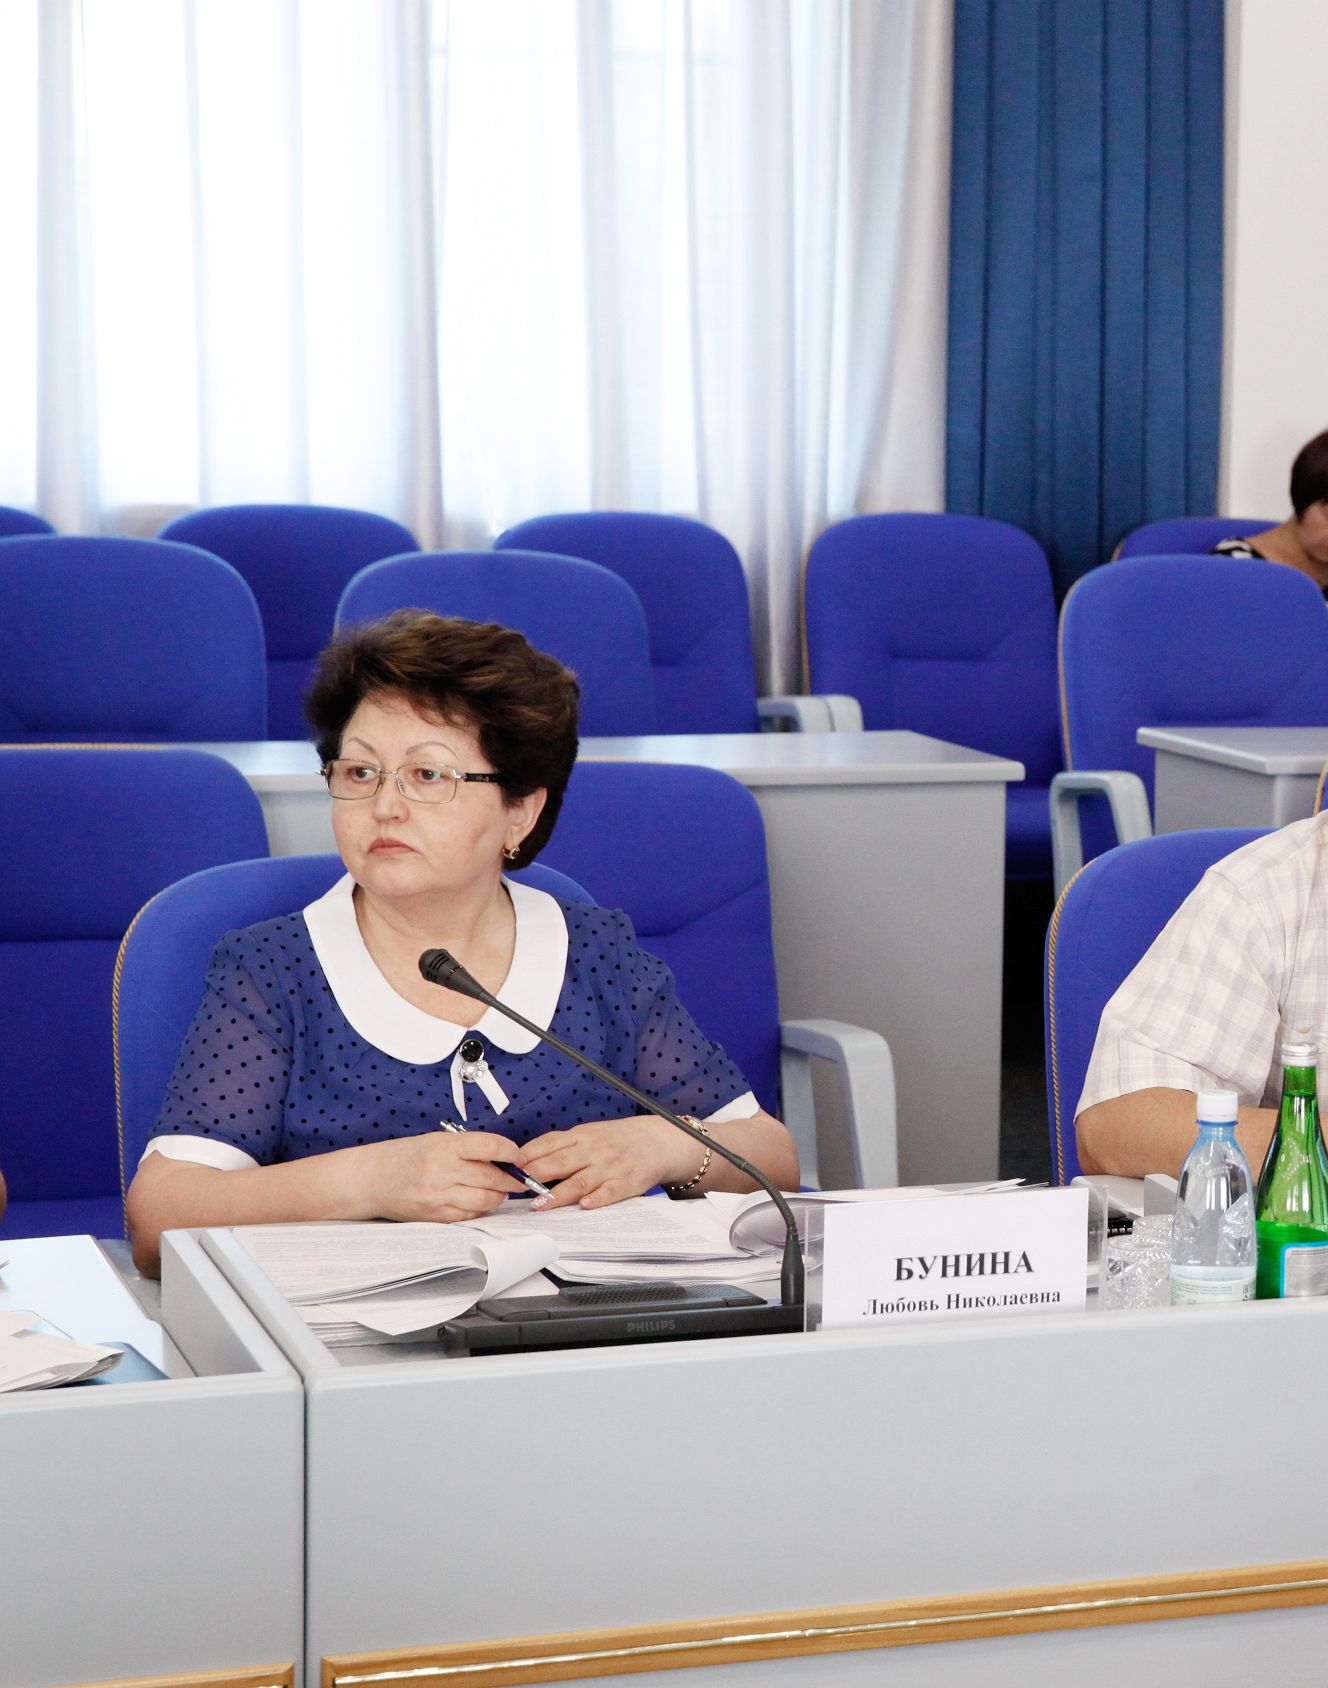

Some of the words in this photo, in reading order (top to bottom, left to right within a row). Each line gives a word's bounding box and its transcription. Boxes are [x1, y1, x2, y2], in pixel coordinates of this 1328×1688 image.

[894, 1250, 1034, 1281] БУНИНА
[862, 1297, 940, 1316] Любовь
[946, 1290, 1061, 1310] Николаевна
[626, 1320, 676, 1333] PHILIPS
